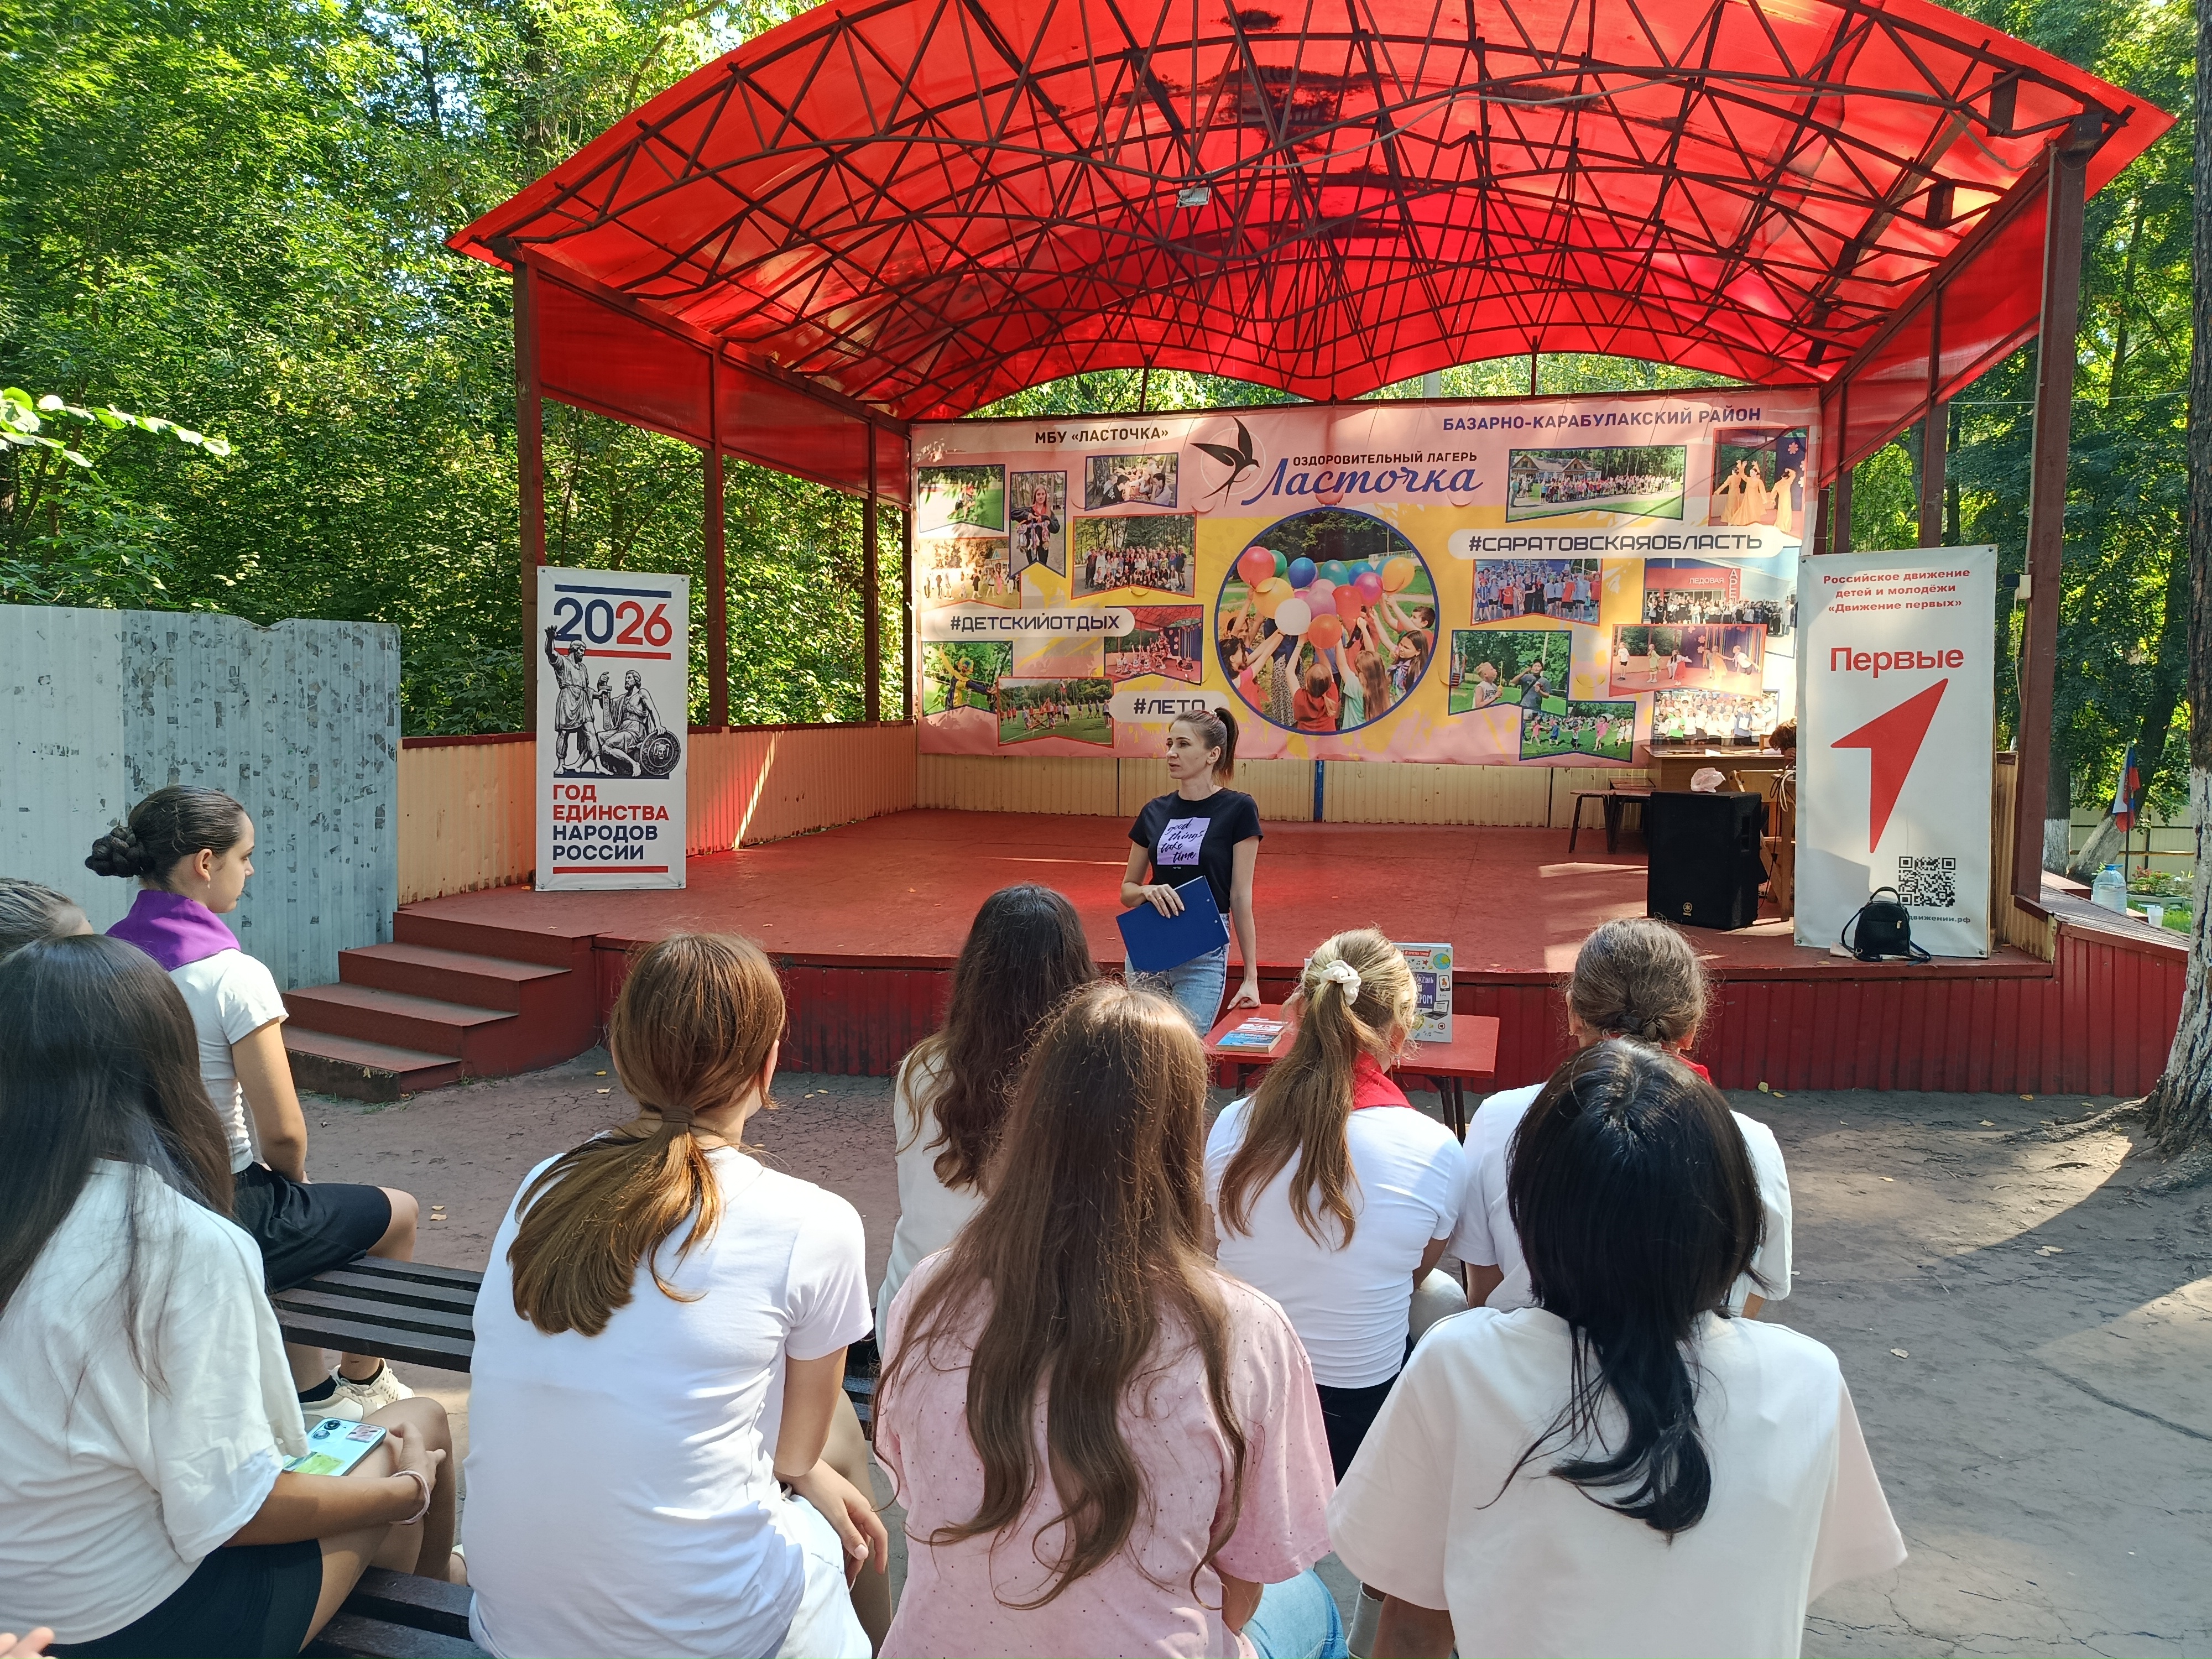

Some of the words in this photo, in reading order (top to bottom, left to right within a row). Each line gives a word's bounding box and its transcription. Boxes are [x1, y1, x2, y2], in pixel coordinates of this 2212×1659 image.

[1443, 407, 1692, 431] БАЗАРНО-КАРАБУЛАКСКИЙ
[1698, 406, 1761, 422] РАЙОН
[1035, 431, 1067, 444] МБУ
[1071, 427, 1168, 442] «ЛАСТОЧКА»
[1293, 450, 1423, 466] ОЗДОРОВИТЕЛЬНЫЙ
[1426, 452, 1478, 463] ЛАГЕРЬ
[1241, 458, 1484, 505] Ласточка
[1468, 534, 1763, 551] #САРАТОВСКАЯОБЛАСТЬ
[1823, 573, 1900, 584] Российское
[1903, 570, 1970, 581] движение
[1835, 587, 1871, 598] детей
[1888, 584, 1955, 596] молодёжи
[1828, 602, 1901, 613] «Движение
[1906, 599, 1962, 609] первых»
[554, 597, 672, 647] 2026
[950, 612, 1120, 632] #ДЕТСКИЙОТДЫХ
[1830, 647, 1964, 678] Первые
[553, 784, 597, 802] ГОД
[553, 805, 670, 824] ЕДИНСТВА
[553, 825, 658, 844] НАРОДОВ
[1164, 818, 1193, 835] good
[1168, 830, 1206, 842] things
[553, 845, 644, 861] РОССИИ
[1161, 841, 1183, 853] take
[1173, 851, 1197, 863] time
[1908, 915, 1971, 924] движении.рф
